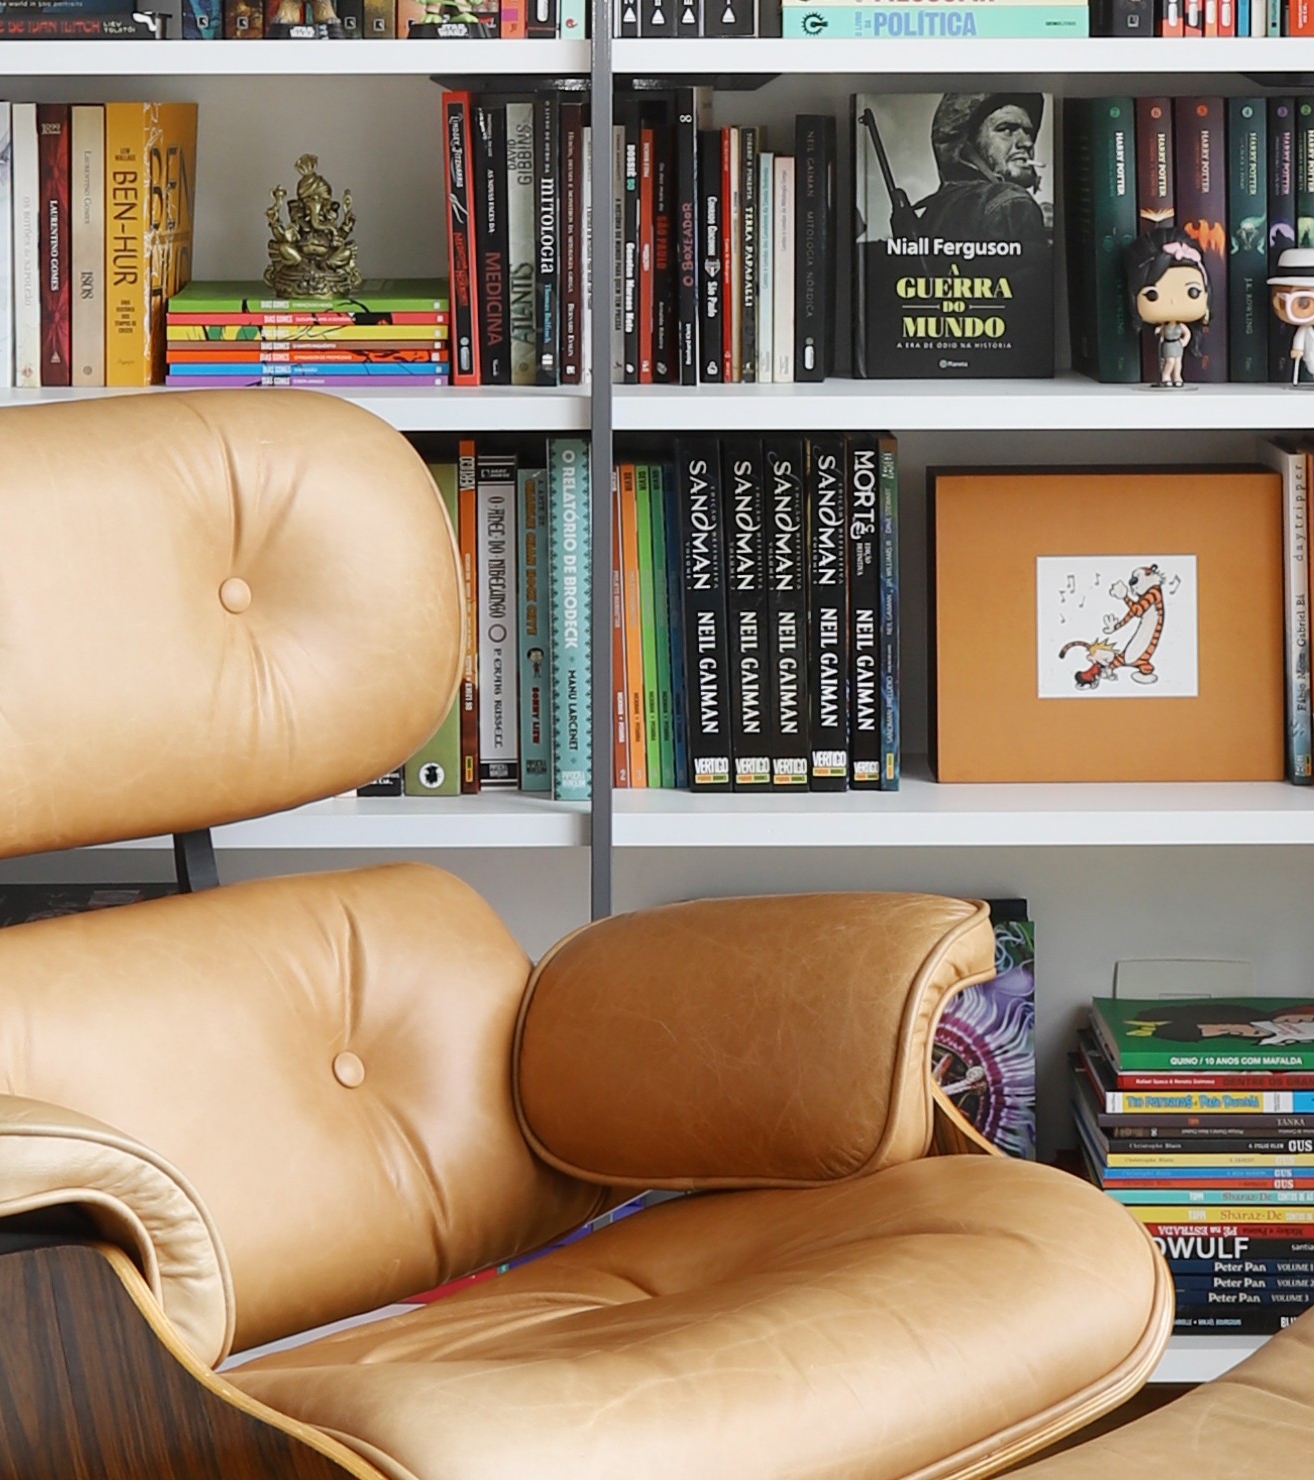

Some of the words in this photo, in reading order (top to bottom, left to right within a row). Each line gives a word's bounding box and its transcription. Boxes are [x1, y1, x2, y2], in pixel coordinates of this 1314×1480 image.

[874, 9, 977, 35] POLÍTICA
[1115, 132, 1125, 162] HARRY
[1115, 163, 1125, 196] POTTER
[49, 200, 58, 257] LAURENTINO
[112, 171, 138, 286] BEN-HUR
[887, 237, 929, 256] Niall
[933, 238, 1021, 260] Ferguson
[50, 258, 59, 291] GOMES
[896, 277, 1013, 298] GUERRA
[485, 252, 502, 346] MEDICINA
[942, 301, 965, 313] DO
[902, 316, 1005, 338] MUNDO
[562, 467, 579, 551] RELATÓRIO
[689, 460, 718, 591] SANDMAN
[563, 554, 577, 575] DE
[563, 576, 578, 649] BRODECK
[697, 612, 716, 653] NEIL
[698, 658, 719, 734] GAIMAN
[693, 758, 729, 774] VERTIGO
[1171, 1057, 1198, 1065] QUINO
[1205, 1057, 1214, 1065] 10
[1216, 1057, 1239, 1065] ANOS
[1241, 1057, 1261, 1065] COM
[1262, 1057, 1303, 1065] MAFALDA
[1288, 1140, 1313, 1152] GUS
[1220, 1209, 1283, 1221] Sharaz-De
[1214, 1261, 1242, 1273] Peter
[1244, 1261, 1267, 1272] Pan
[1277, 1263, 1306, 1271] VOLUME
